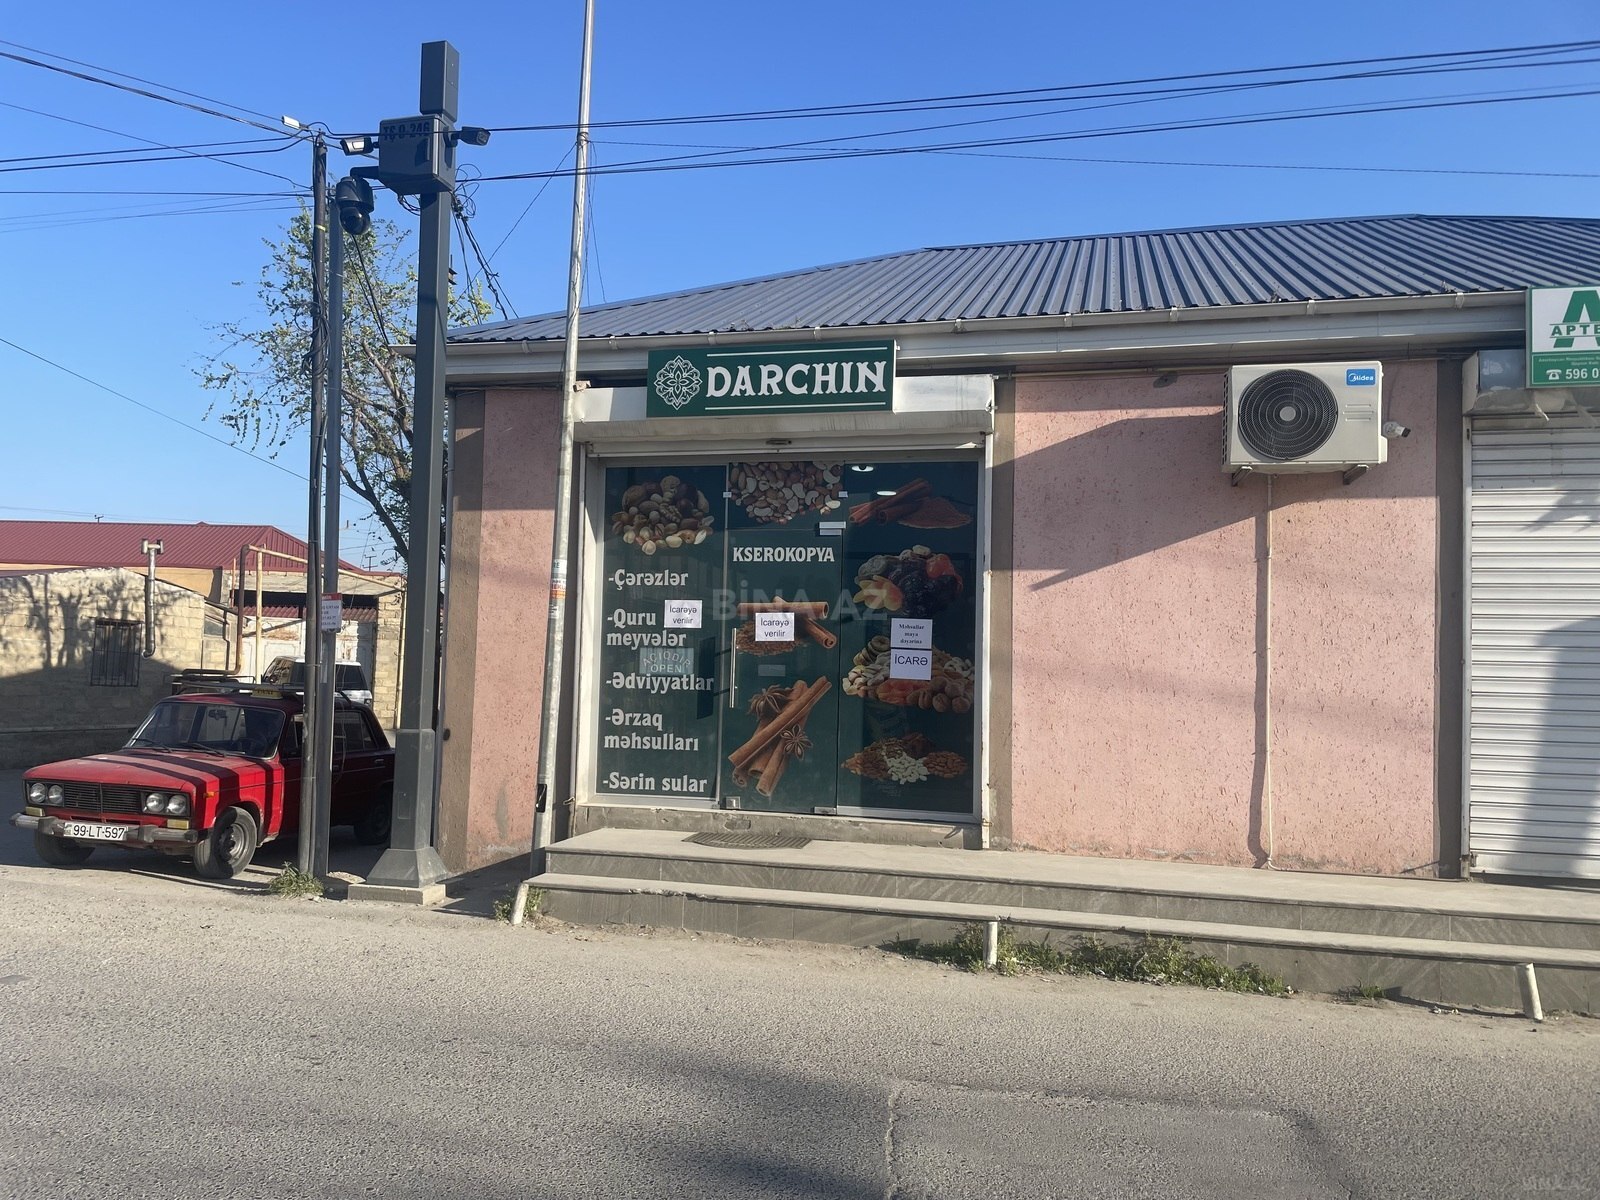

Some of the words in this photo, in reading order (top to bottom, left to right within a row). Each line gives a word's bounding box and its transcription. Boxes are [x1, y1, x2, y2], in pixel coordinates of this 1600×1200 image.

[706, 361, 887, 397] DARCHIN
[1565, 368, 1588, 379] 596
[1592, 367, 1600, 379] 0
[733, 547, 835, 562] KSEROKOPYA
[760, 617, 790, 628] İcarəyə
[606, 629, 687, 650] meyvələr
[894, 653, 928, 666] İCARƏ
[650, 664, 682, 673] OPEN
[603, 732, 699, 751] məhsulları
[661, 774, 708, 792] sular
